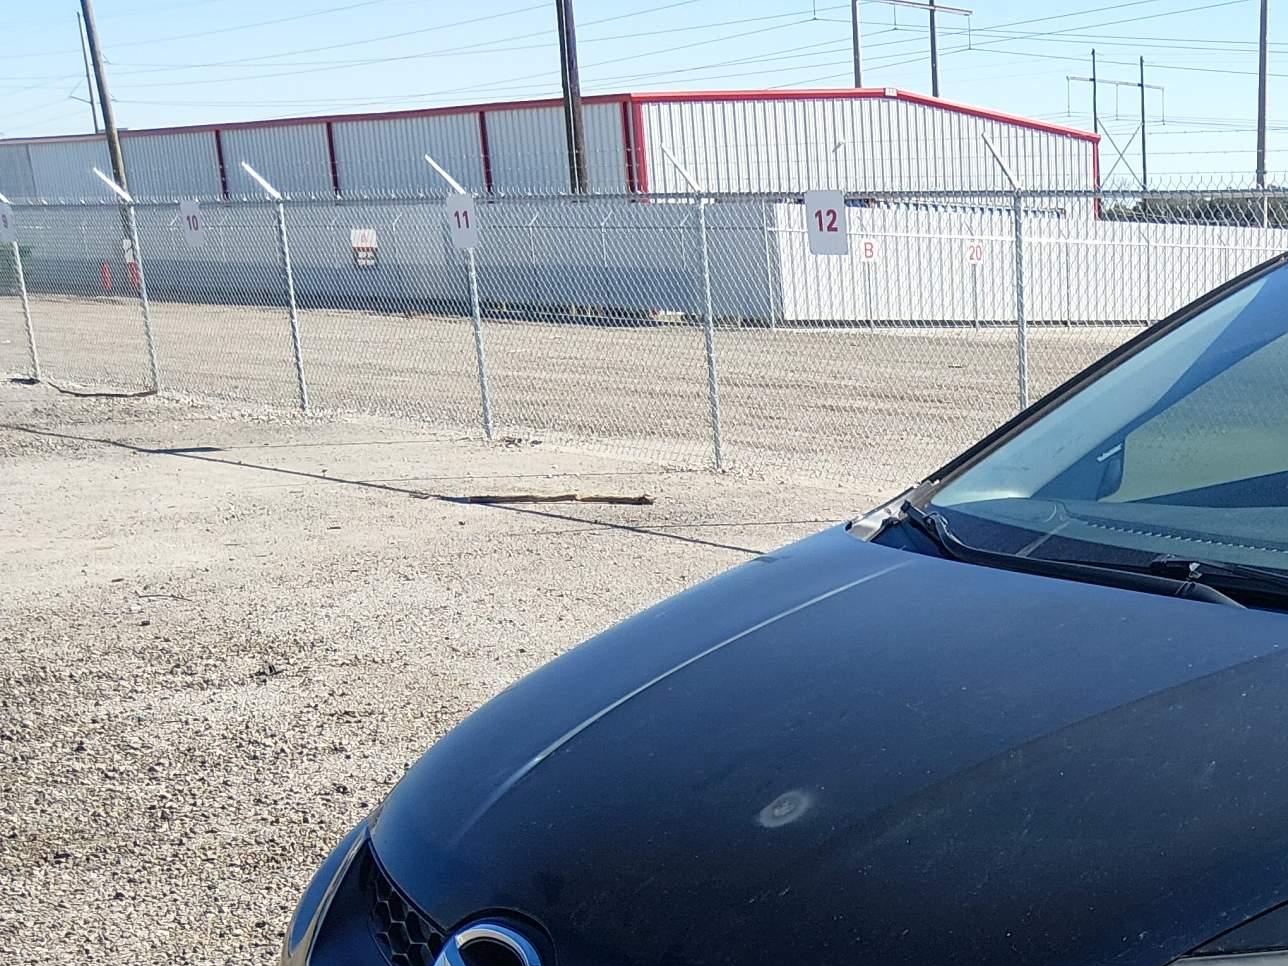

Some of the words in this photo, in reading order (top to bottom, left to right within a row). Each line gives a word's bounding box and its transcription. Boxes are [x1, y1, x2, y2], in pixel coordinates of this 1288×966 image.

[186, 215, 199, 230] 10
[454, 210, 470, 229] 11
[814, 208, 838, 232] 12
[863, 242, 875, 259] B
[968, 245, 983, 262] 20
